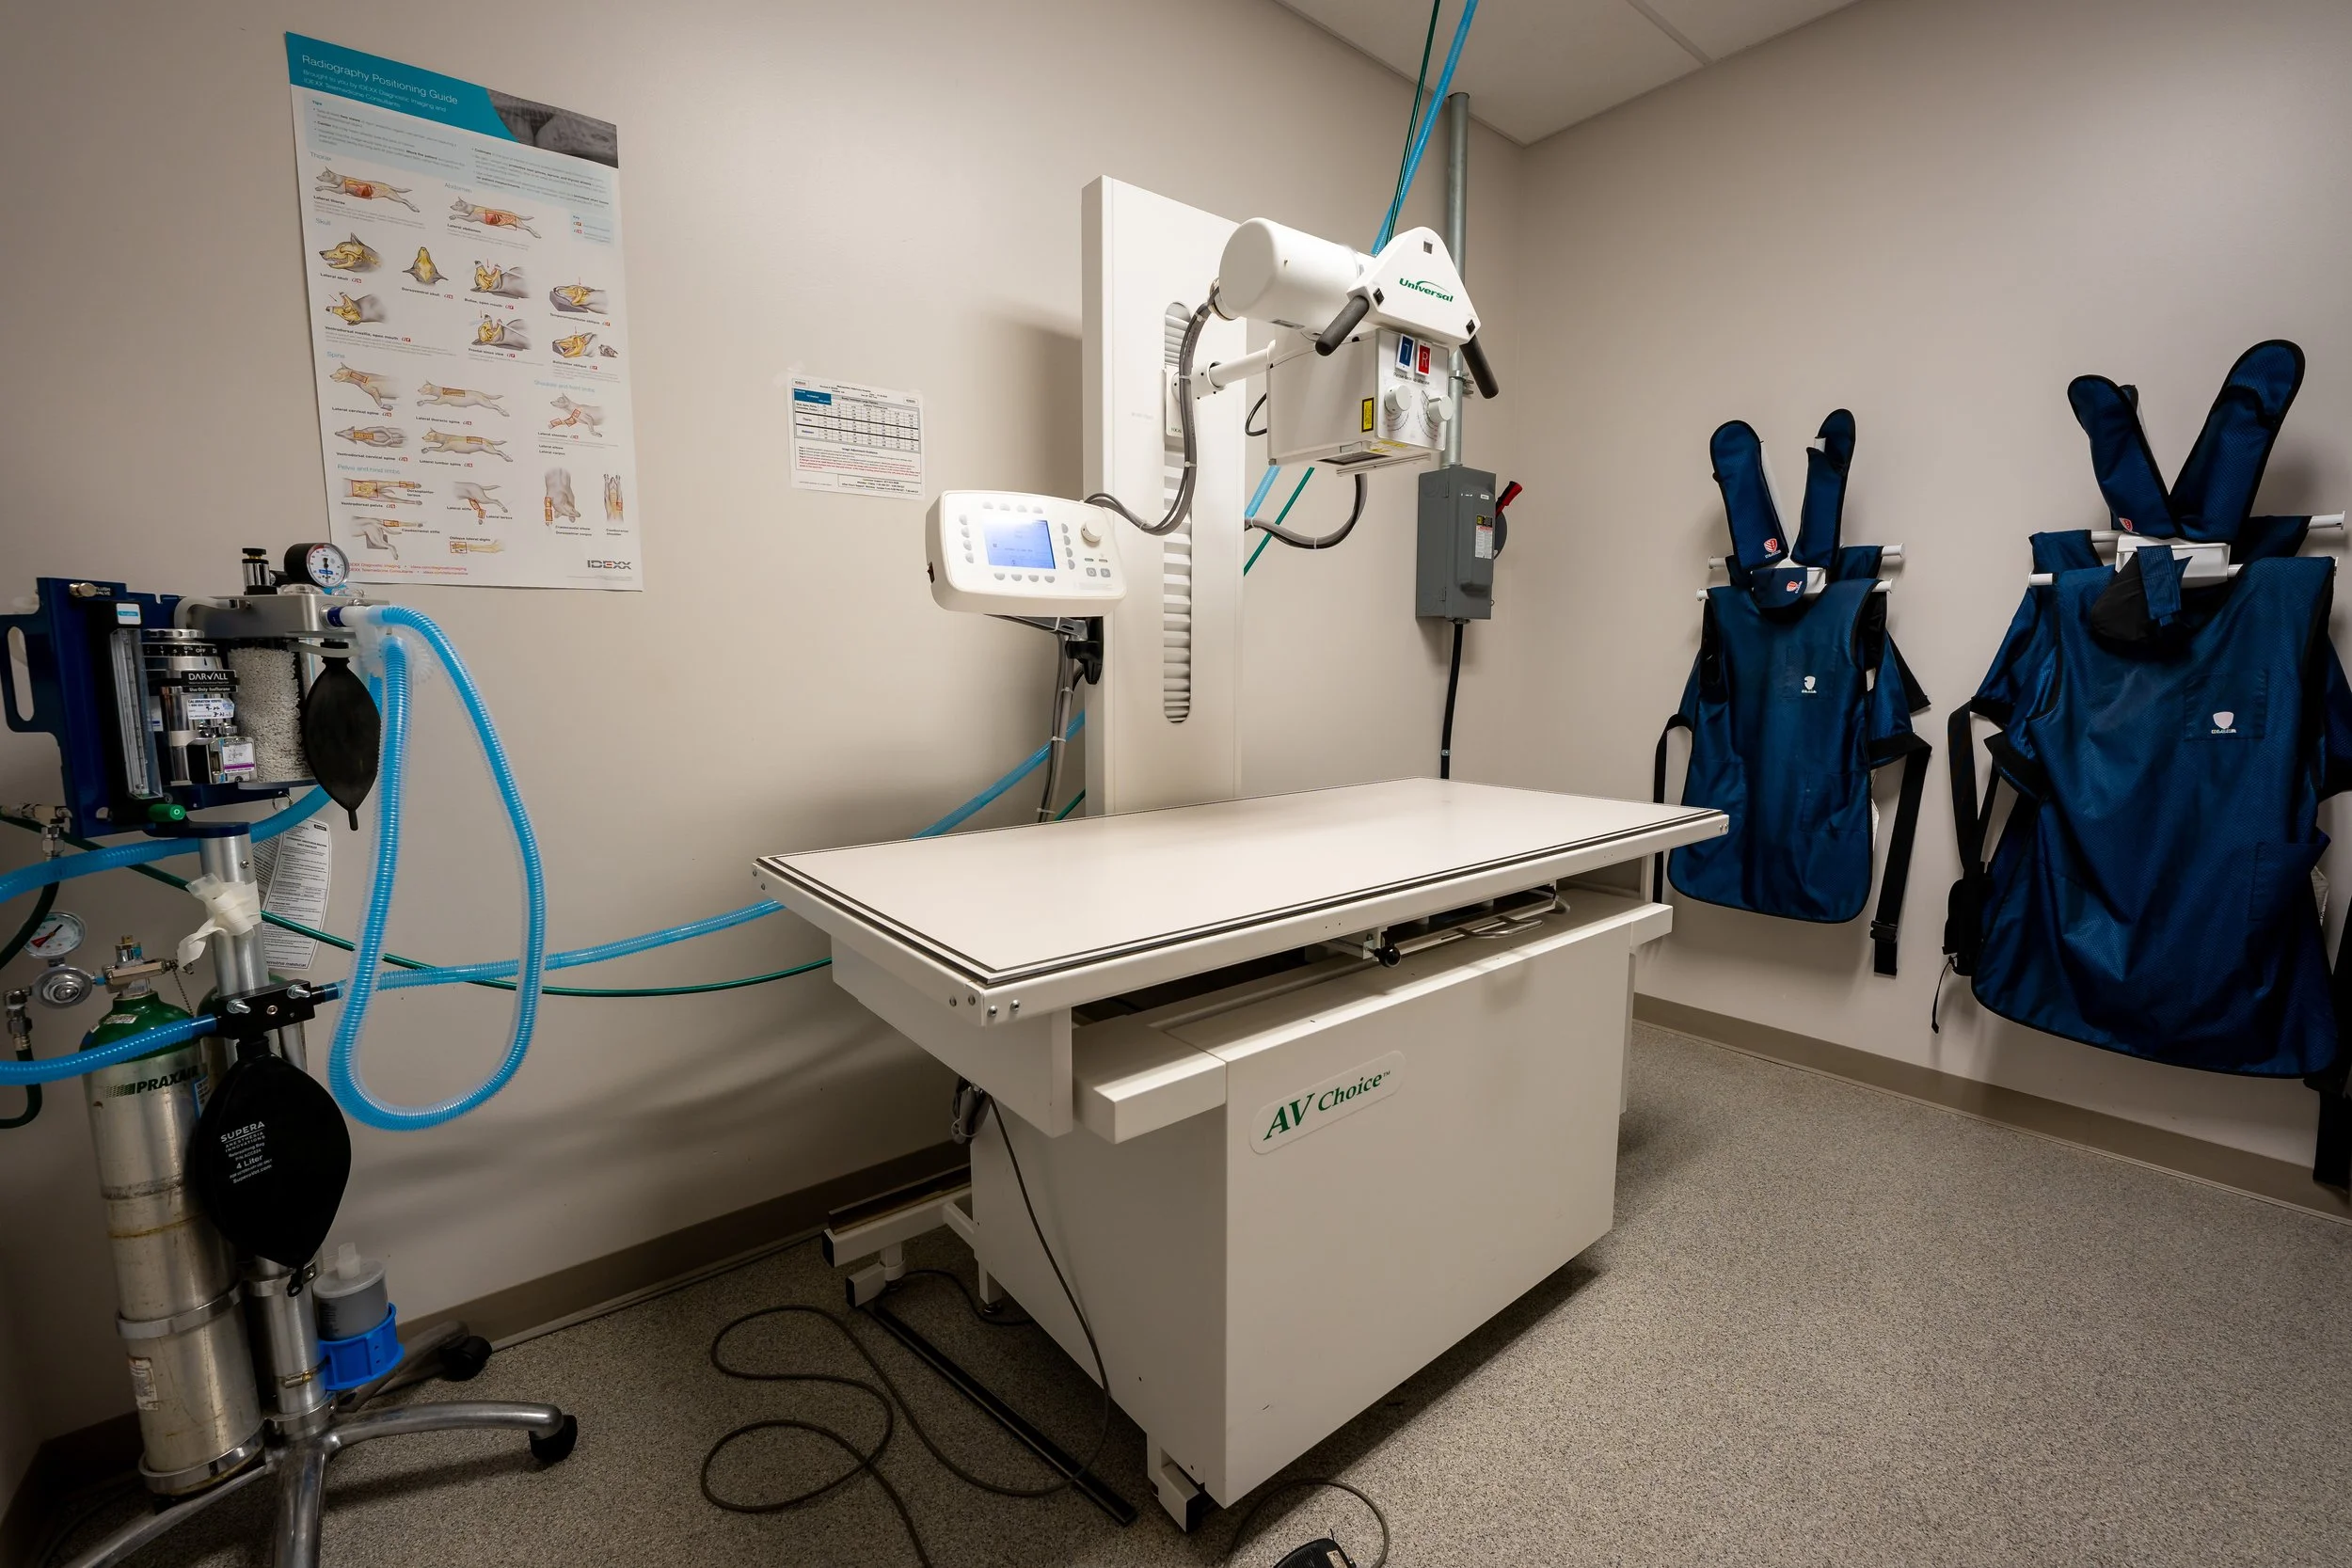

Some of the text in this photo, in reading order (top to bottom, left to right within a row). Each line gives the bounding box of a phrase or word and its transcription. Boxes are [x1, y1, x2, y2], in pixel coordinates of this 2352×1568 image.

[302, 55, 458, 105] Radiography Positioning Guide
[304, 70, 328, 81] Brought
[336, 78, 349, 87] you
[360, 85, 377, 94] IDEXX
[379, 89, 410, 103] Diagnostic
[411, 98, 434, 109] Imaging
[435, 104, 446, 113] and
[1399, 278, 1454, 302] Universal
[1422, 351, 1428, 368] R
[587, 560, 631, 569] IDEXX
[188, 672, 228, 680] DARVALL
[136, 1066, 198, 1093] PRAXAIR
[1263, 1093, 1315, 1141] AV
[220, 1121, 265, 1142] SUPERA
[226, 1132, 263, 1148] ANESTHESIA
[226, 1135, 265, 1153] INNOVATIONS
[244, 1155, 263, 1166] Liter
